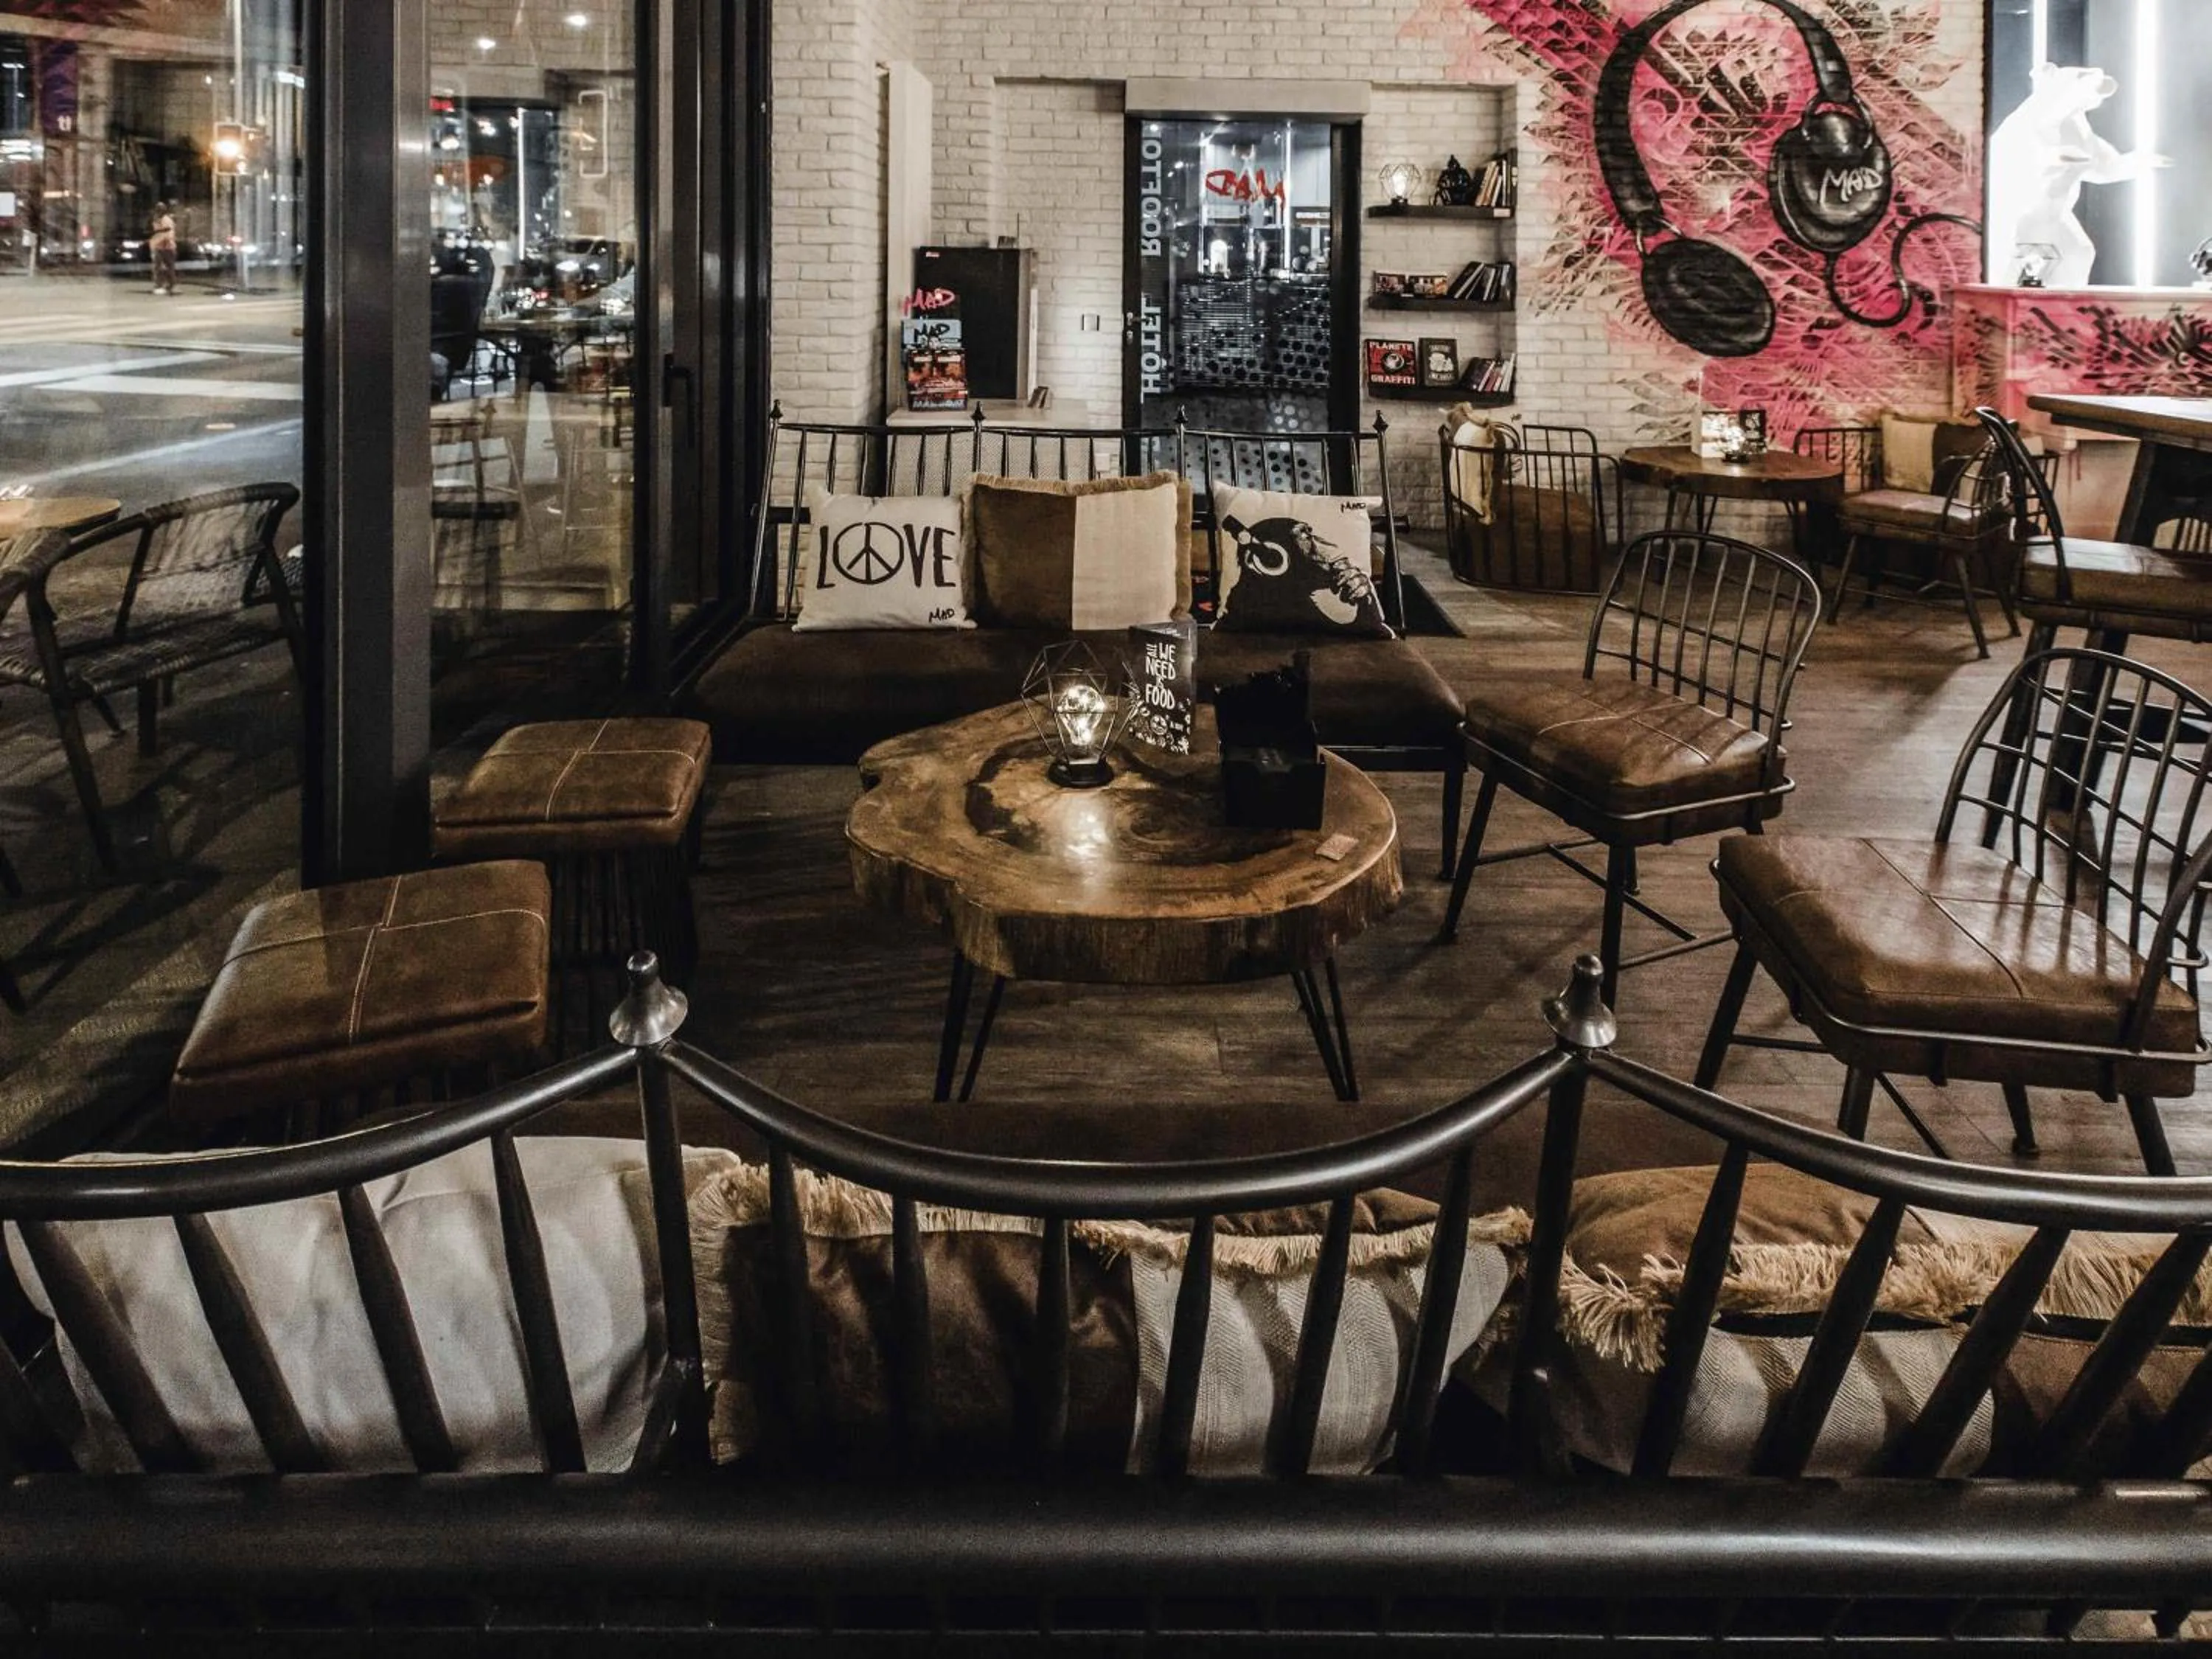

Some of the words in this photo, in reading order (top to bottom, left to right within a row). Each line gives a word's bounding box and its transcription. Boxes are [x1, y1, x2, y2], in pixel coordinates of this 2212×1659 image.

[1819, 166, 1883, 204] MAD
[902, 288, 956, 317] MAD
[914, 323, 950, 344] MAD
[1371, 374, 1416, 384] GRAFFITI
[817, 521, 956, 590] LOVE
[928, 608, 955, 622] MAD
[1158, 642, 1177, 663] WE
[1145, 655, 1177, 681] NEED
[1145, 683, 1176, 710] FOOD
